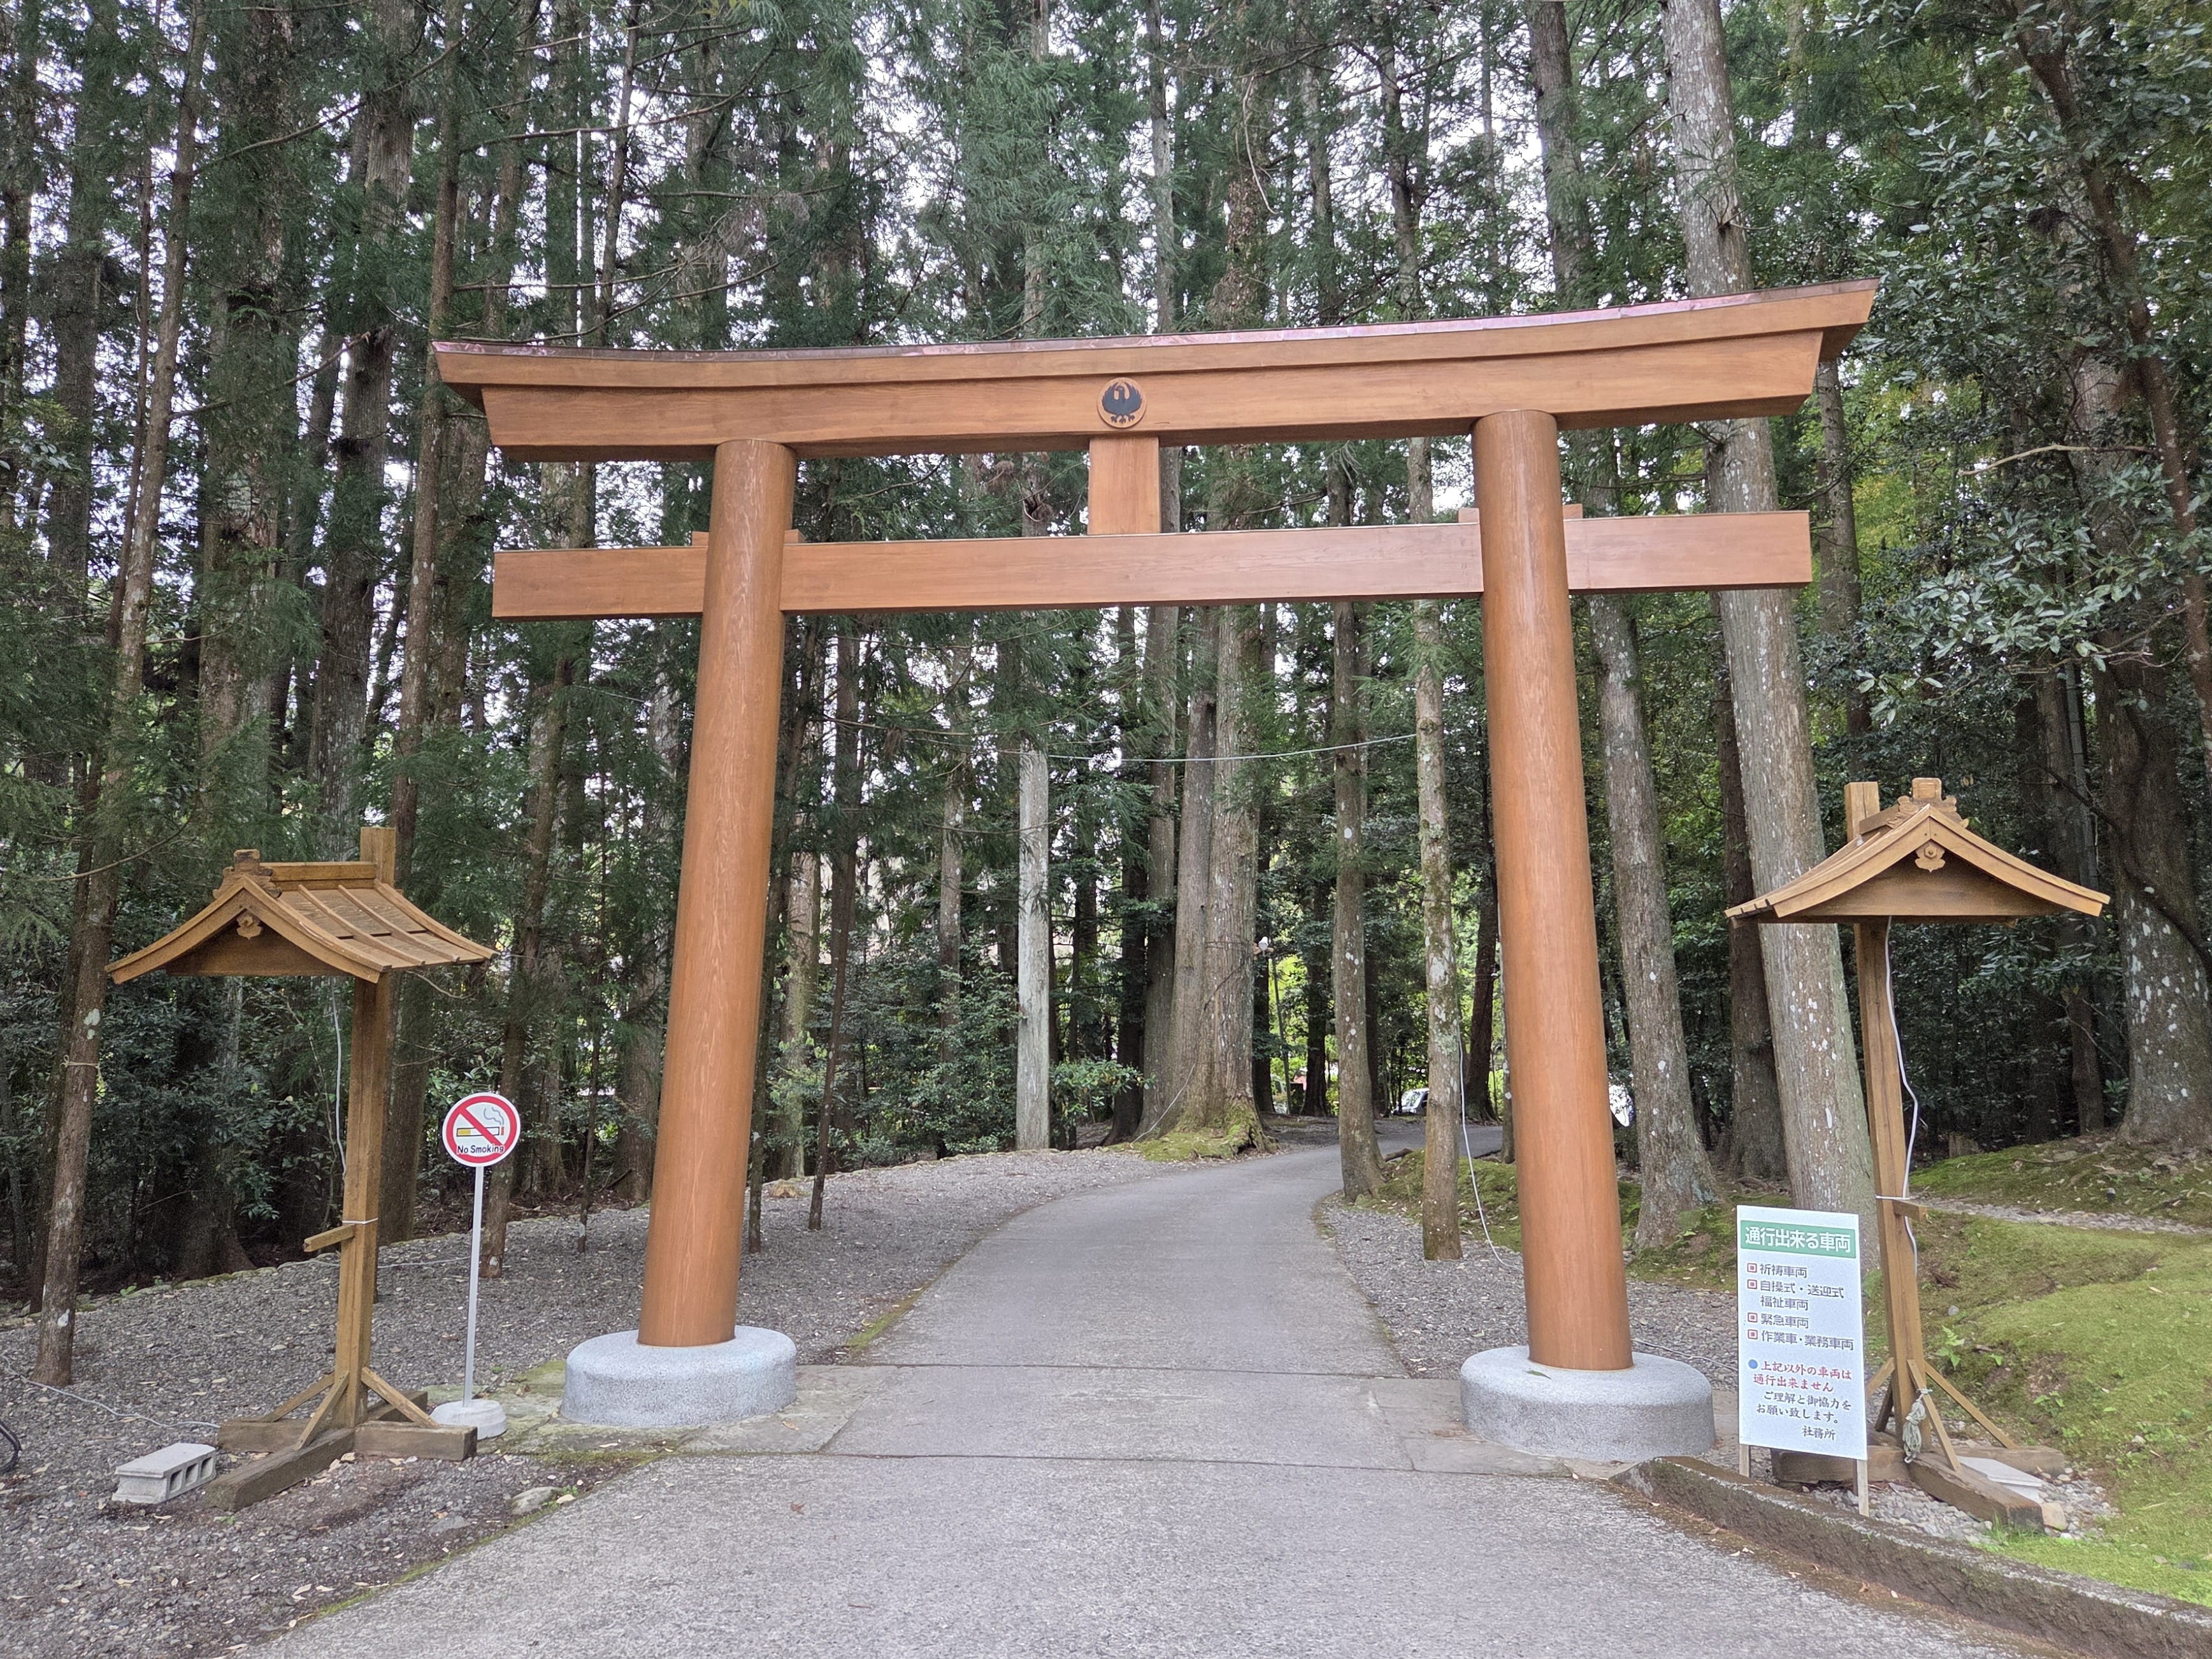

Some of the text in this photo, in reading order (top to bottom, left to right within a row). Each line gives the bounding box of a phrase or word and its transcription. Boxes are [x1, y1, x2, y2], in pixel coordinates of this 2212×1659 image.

[457, 1144, 504, 1153] No Smoking
[1745, 1226, 1851, 1253] 通行出来る車両
[1760, 1263, 1807, 1278] 祈祷車両
[1760, 1281, 1844, 1298] 自操式・送迎式
[1760, 1295, 1808, 1311] 福祉車両
[1761, 1313, 1809, 1328] 緊急車両
[1762, 1330, 1854, 1350] 作業車・業務車両
[1761, 1361, 1851, 1379] 上記以外の車両は
[1753, 1374, 1834, 1392] 通行出来ません
[1764, 1391, 1851, 1411] ご理解と御協力を
[1756, 1404, 1838, 1424] お願い致します。
[1802, 1425, 1836, 1440] 社務所
